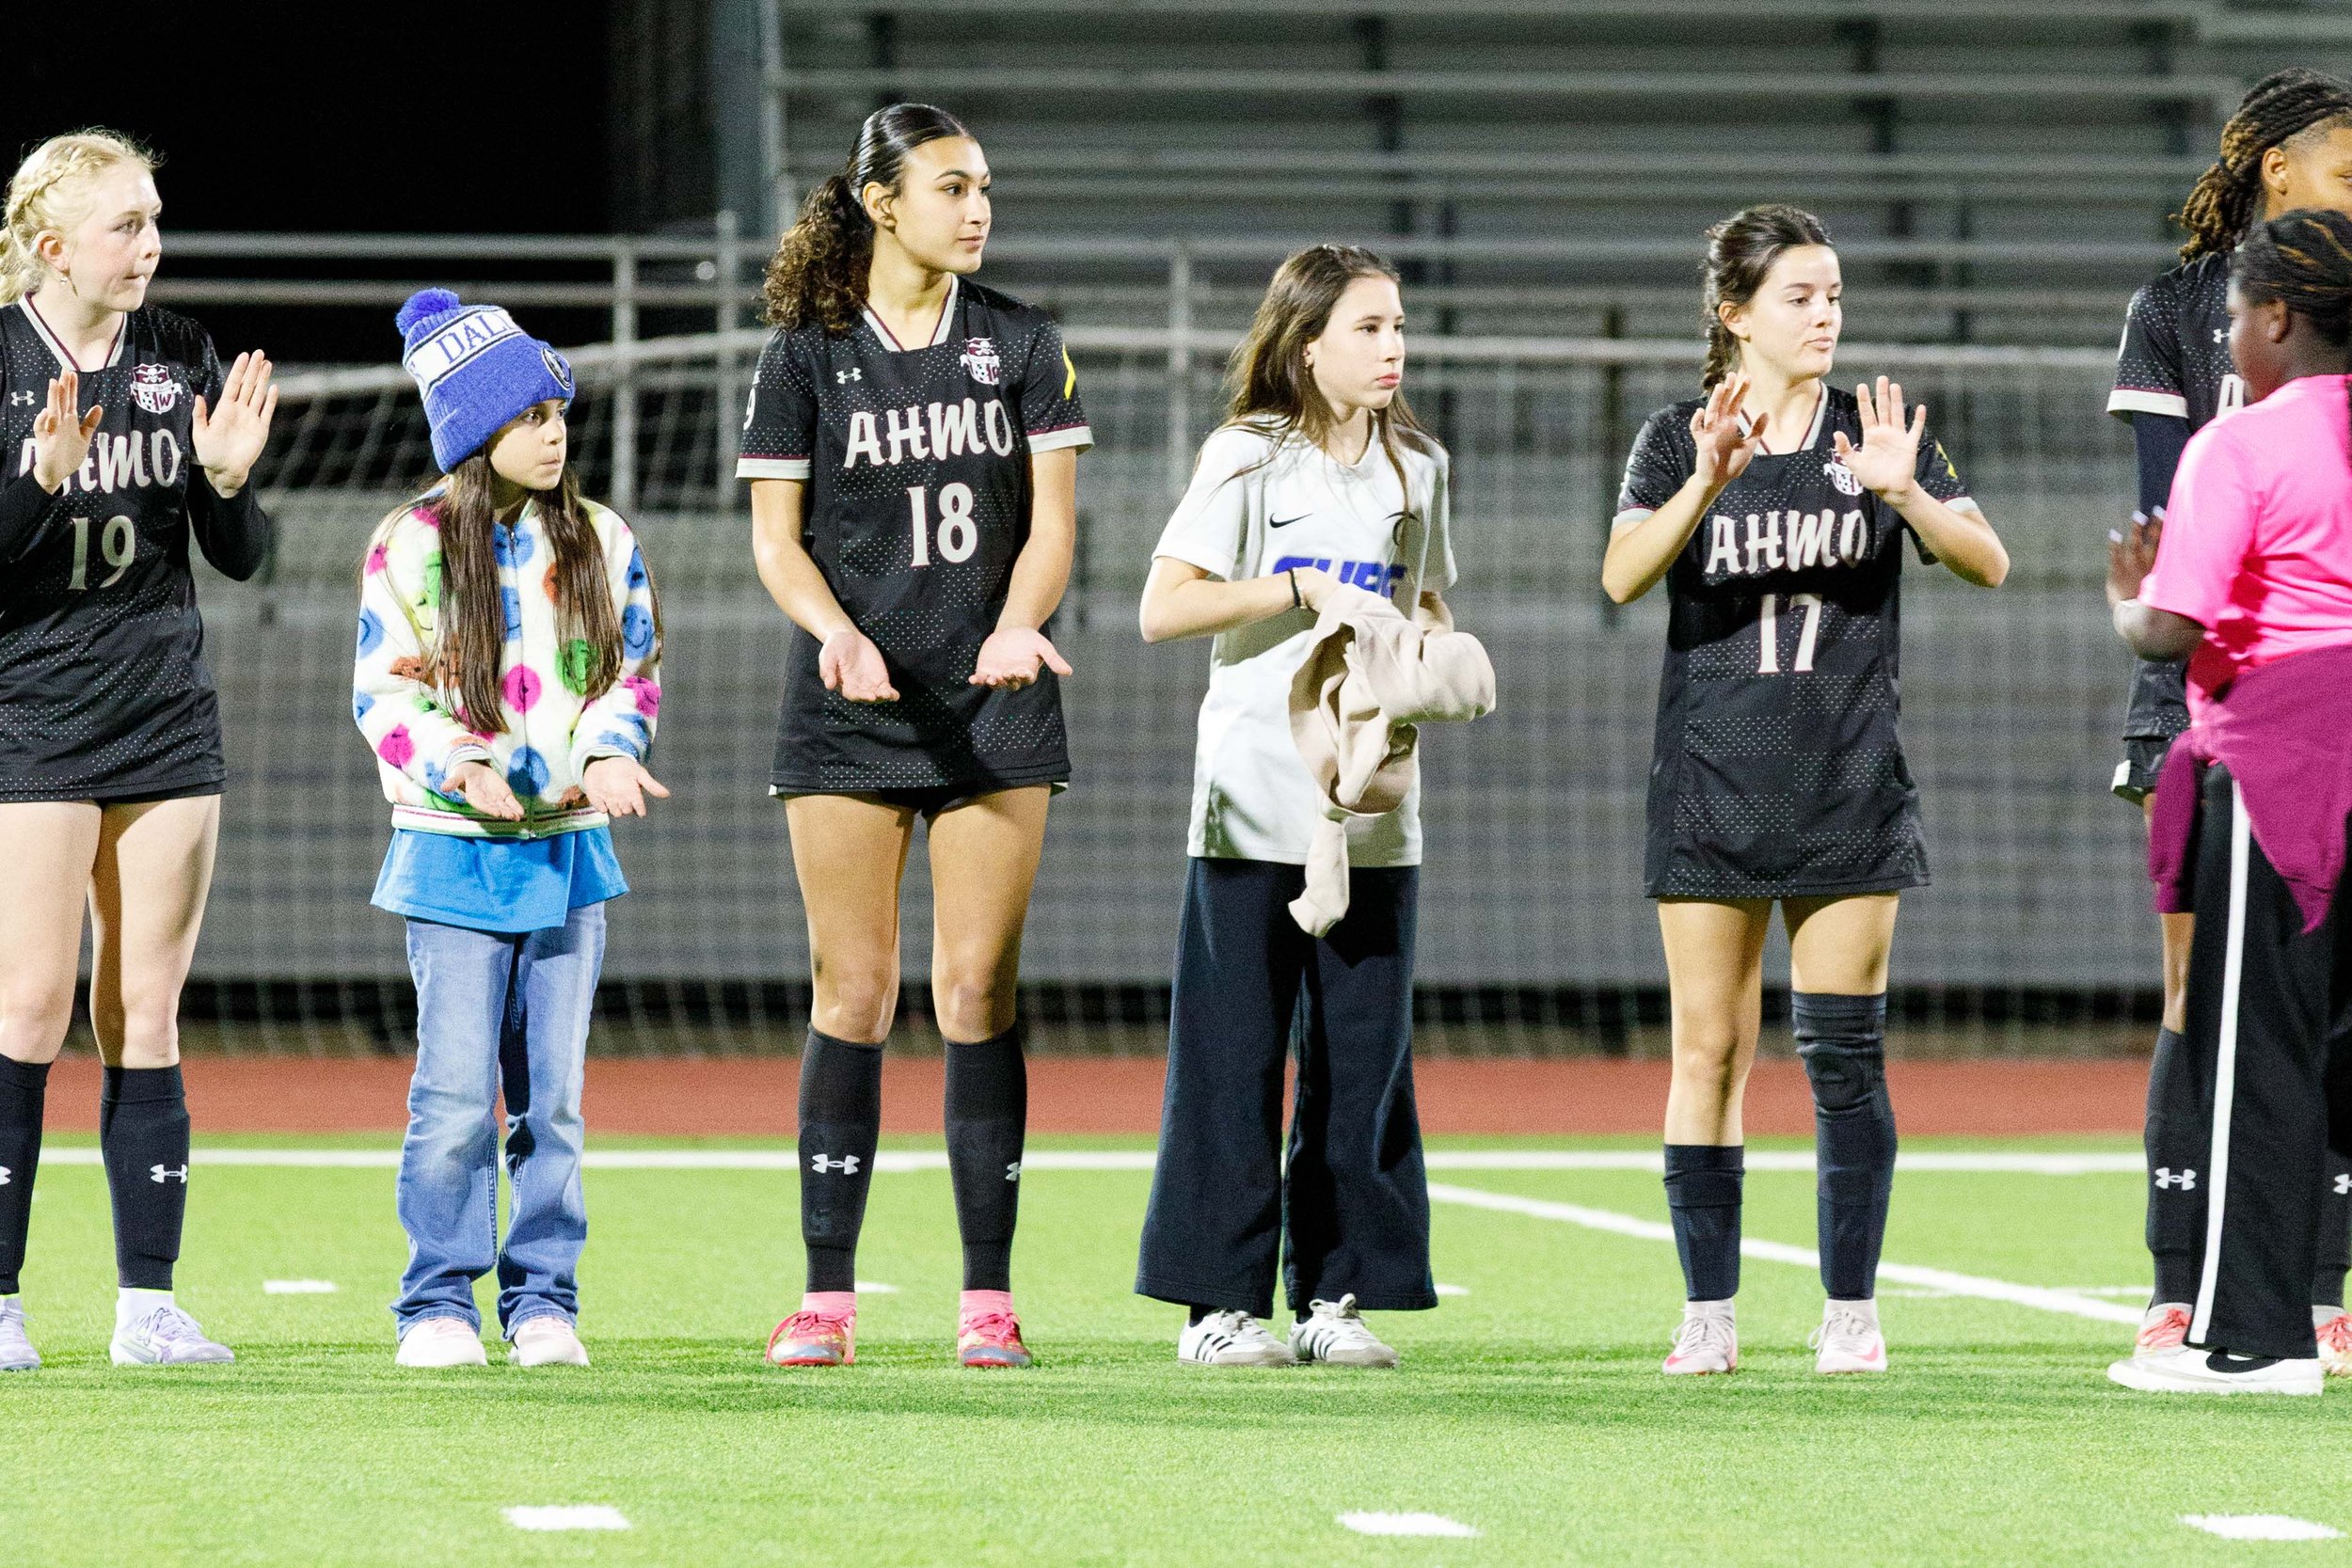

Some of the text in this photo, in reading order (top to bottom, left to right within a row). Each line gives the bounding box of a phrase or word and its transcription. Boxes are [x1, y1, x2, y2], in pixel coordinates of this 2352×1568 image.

[844, 397, 1014, 468] AHMO
[67, 515, 136, 591] 19
[906, 482, 978, 567] 18
[1704, 508, 1867, 574] AHMO
[1757, 593, 1823, 674] 17
